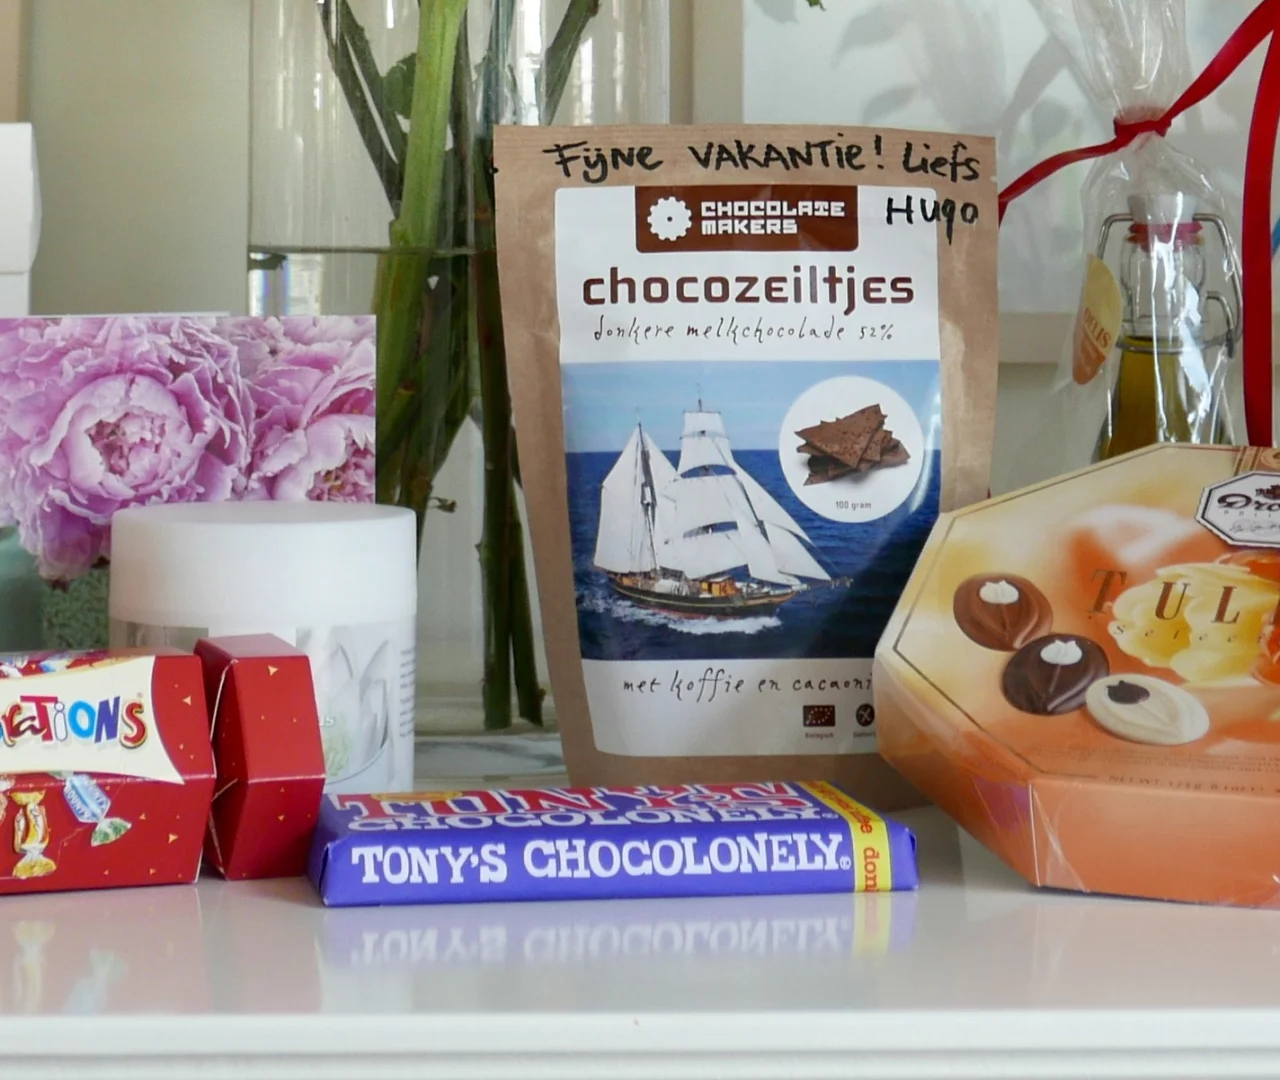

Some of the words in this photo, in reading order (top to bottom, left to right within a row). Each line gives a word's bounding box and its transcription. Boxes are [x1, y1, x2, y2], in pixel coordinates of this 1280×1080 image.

[701, 201, 846, 217] CHOCOLATE
[701, 219, 798, 235] MAKERS
[886, 195, 980, 246] Hugo
[582, 265, 915, 317] chocozeiltjes
[594, 316, 675, 344] donkere
[687, 317, 846, 344] melkchocolade
[859, 324, 894, 341] 52%
[623, 677, 661, 693] met
[670, 667, 744, 703] koffie
[757, 678, 781, 692] en
[792, 672, 872, 693] cacaoni
[351, 842, 507, 884] TONY'S
[523, 832, 844, 880] CHOCOLONELY
